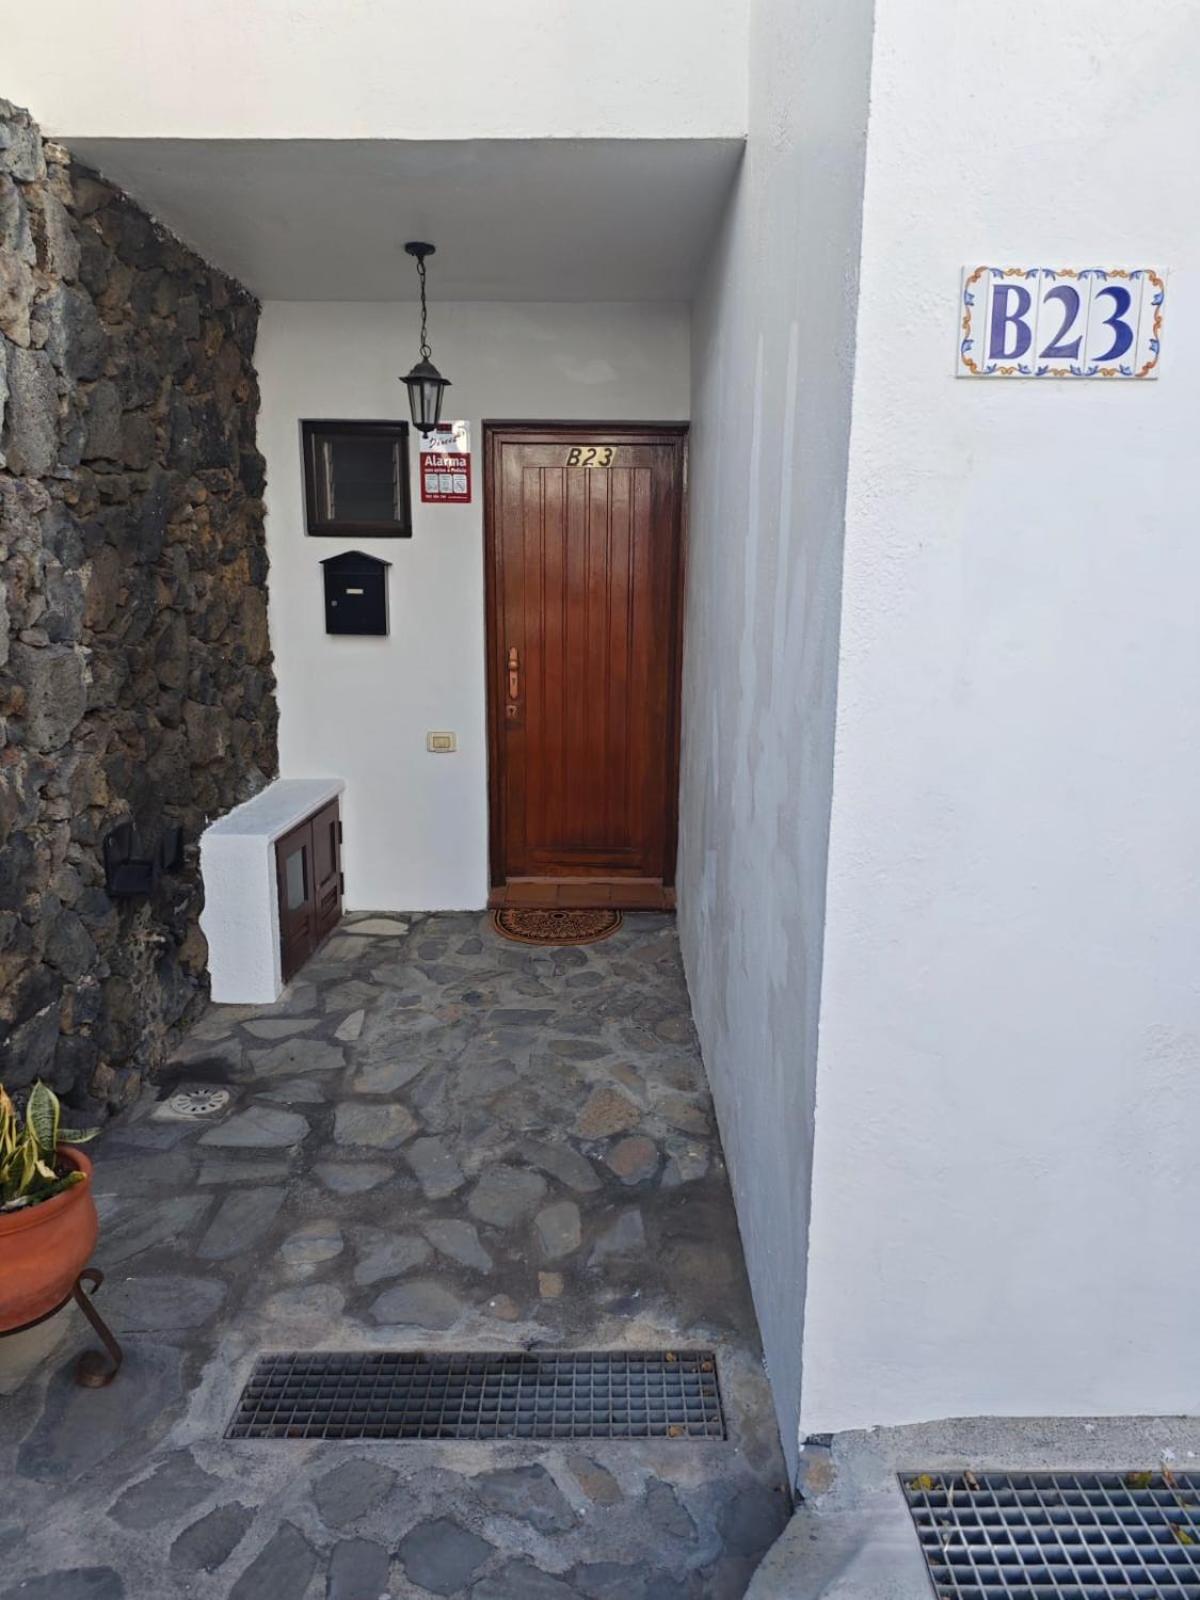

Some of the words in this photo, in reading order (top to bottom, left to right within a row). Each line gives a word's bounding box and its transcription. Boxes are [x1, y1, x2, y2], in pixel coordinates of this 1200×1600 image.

[987, 283, 1135, 363] B23
[424, 454, 467, 467] Alarma
[566, 447, 613, 467] B23
